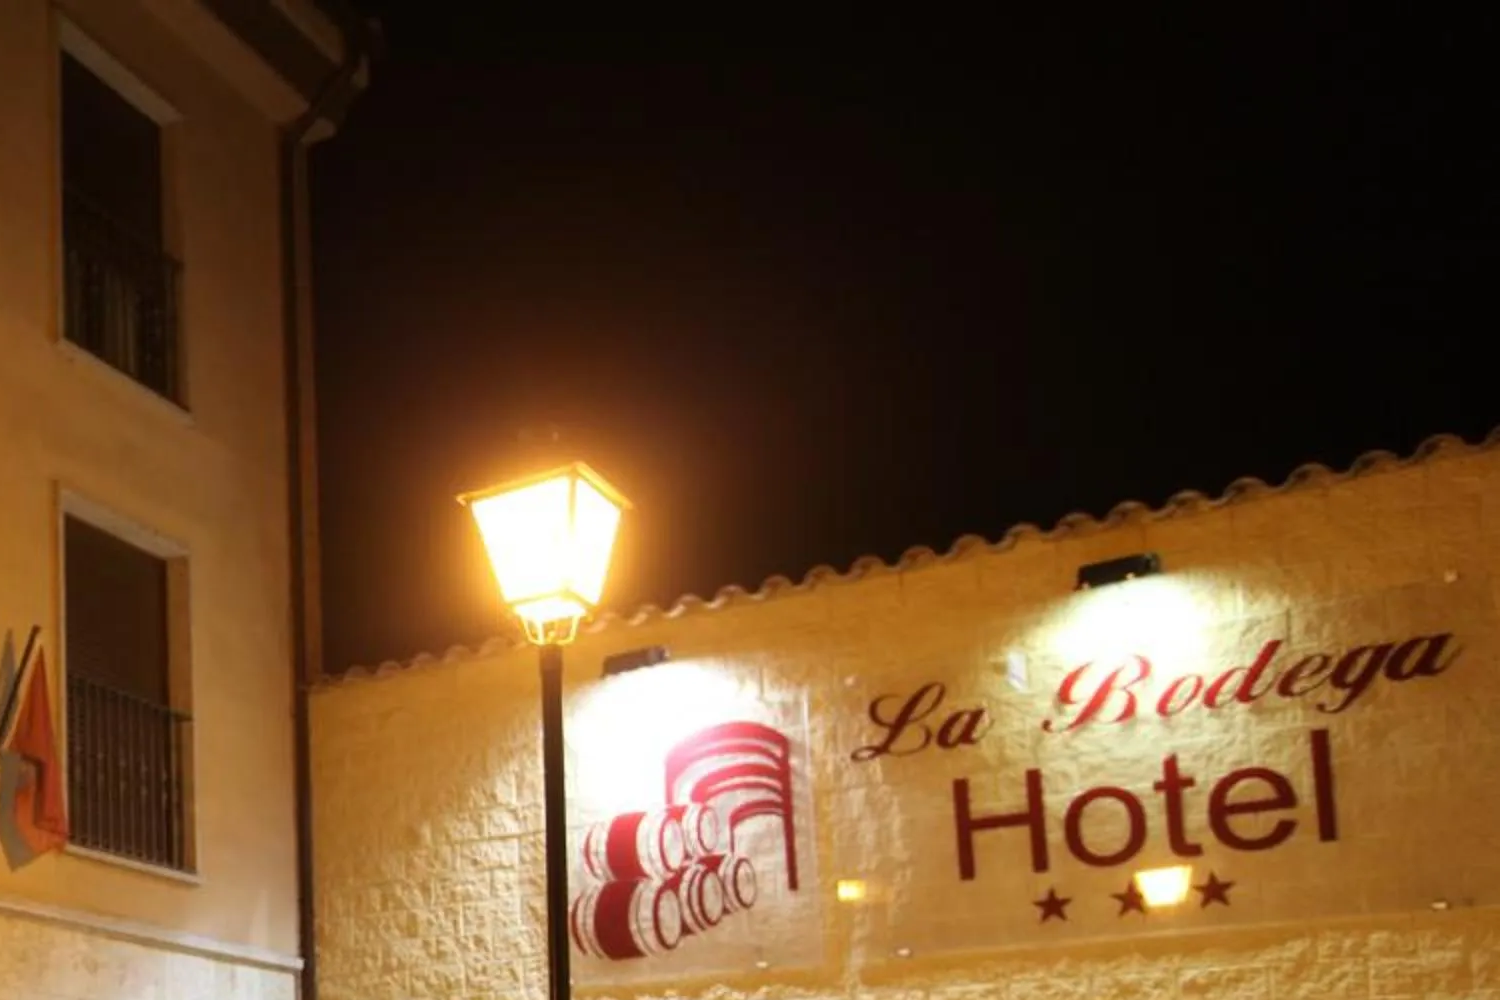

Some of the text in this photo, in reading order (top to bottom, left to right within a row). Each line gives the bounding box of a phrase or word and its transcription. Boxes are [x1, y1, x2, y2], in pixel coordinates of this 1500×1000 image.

[850, 631, 1459, 761] La Bodega
[951, 728, 1340, 882] Hotel
